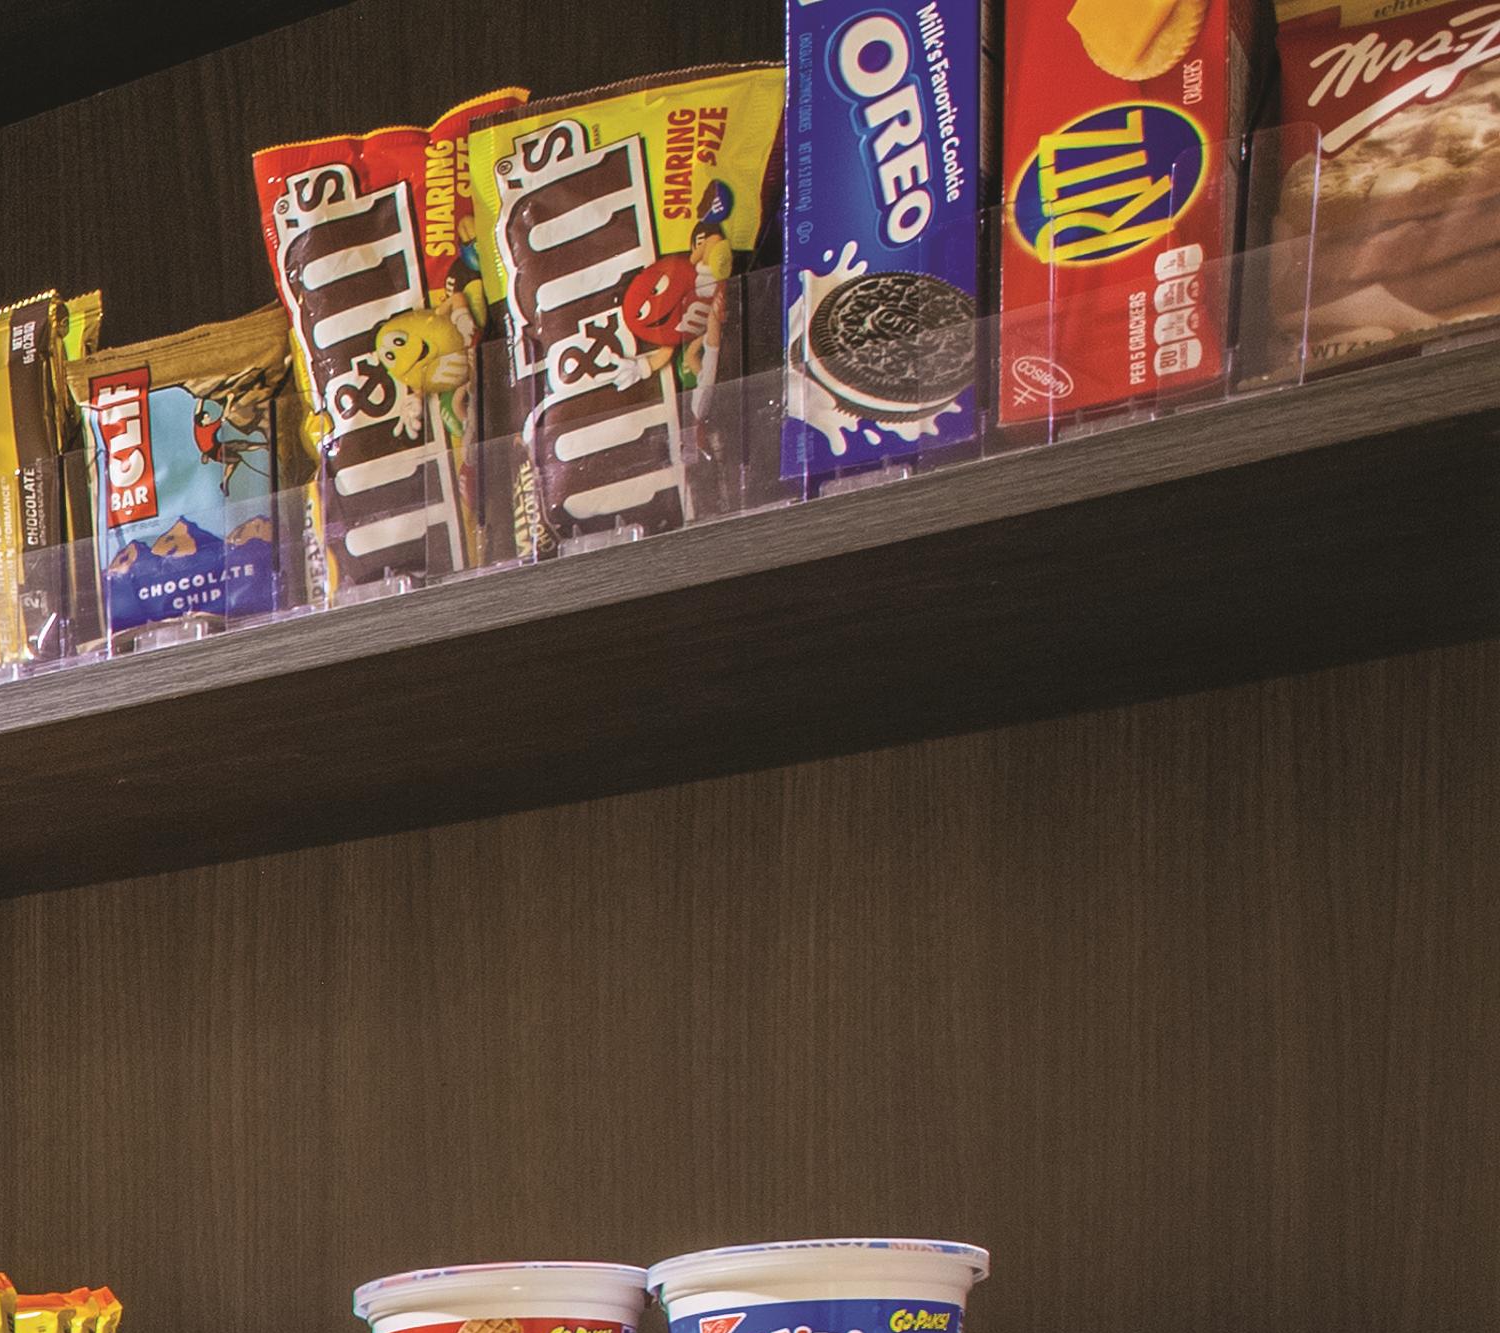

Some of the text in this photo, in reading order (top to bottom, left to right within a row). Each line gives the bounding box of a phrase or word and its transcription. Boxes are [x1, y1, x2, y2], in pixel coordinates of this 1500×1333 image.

[663, 109, 696, 220] SHARING
[696, 106, 728, 166] SIZE
[840, 16, 931, 243] OREO
[929, 57, 964, 202] Favorite Cookie
[426, 139, 454, 256] SHARING
[1036, 109, 1174, 264] RITZ
[1130, 291, 1147, 385] PER CRACKERS
[97, 384, 146, 487] CLIF
[23, 467, 37, 545] CHOCOLATE
[110, 487, 148, 512] BAR
[138, 563, 255, 600] CHOCOLATE
[173, 589, 221, 609] CHIP
